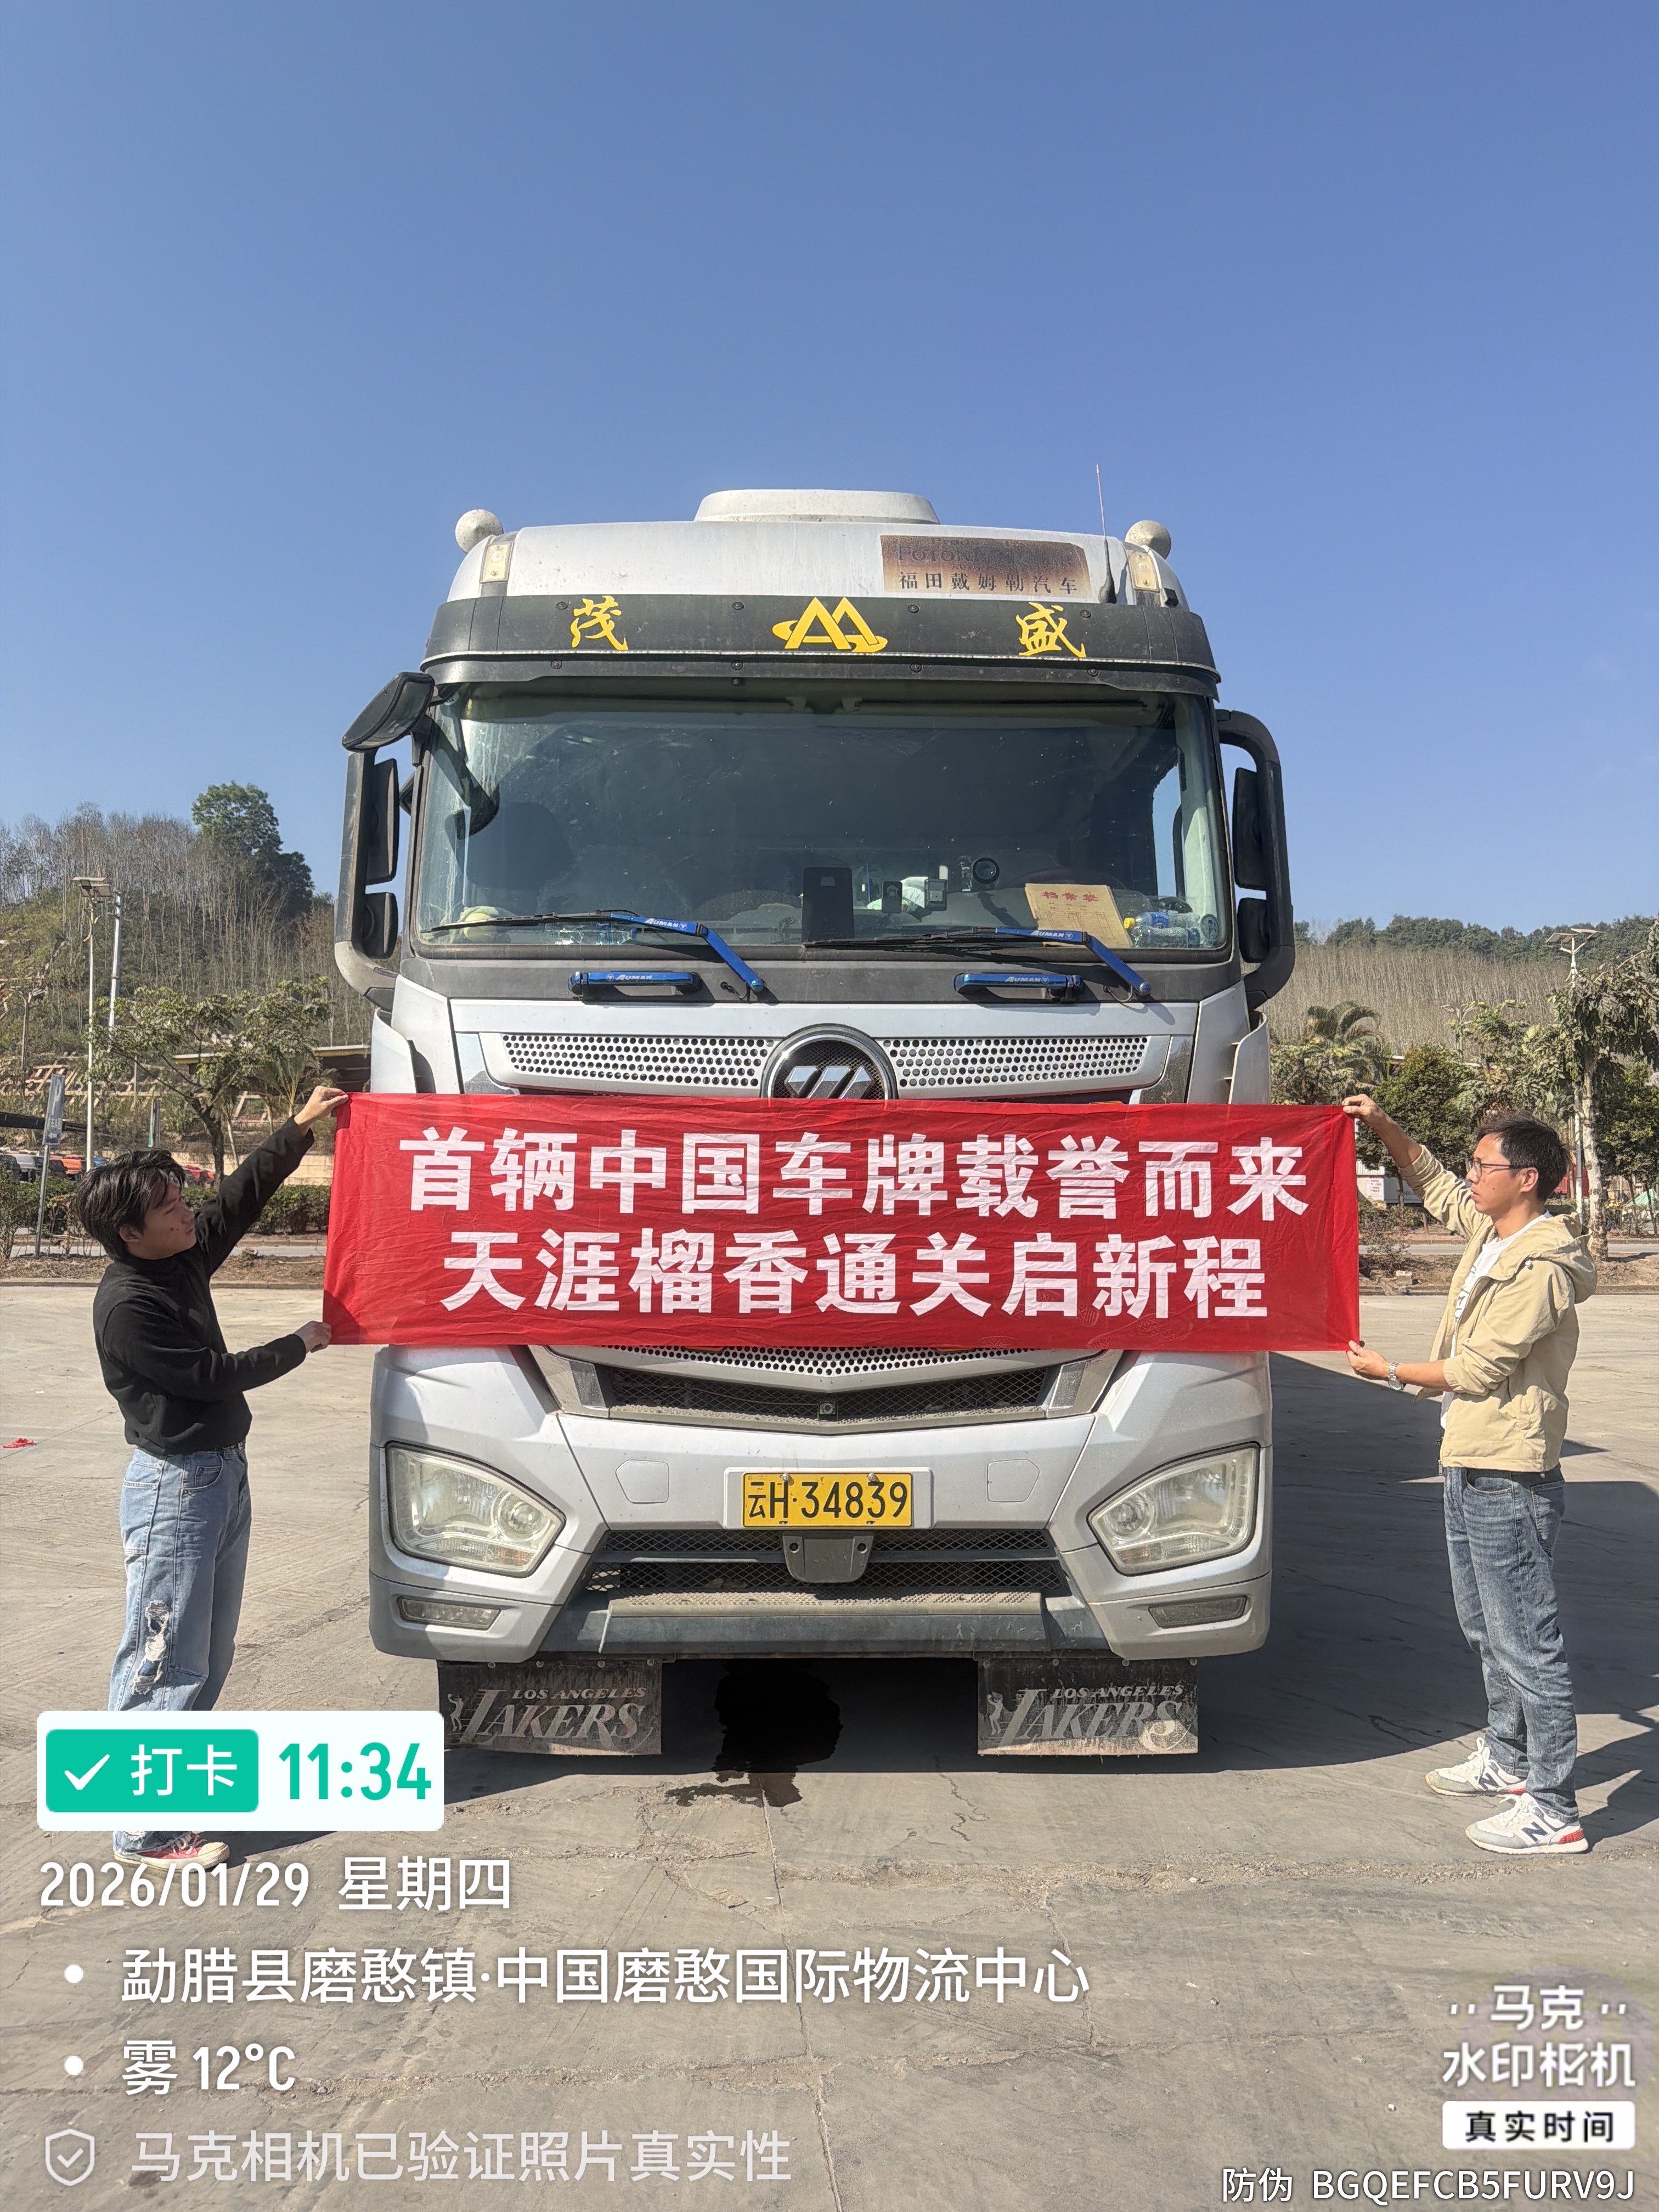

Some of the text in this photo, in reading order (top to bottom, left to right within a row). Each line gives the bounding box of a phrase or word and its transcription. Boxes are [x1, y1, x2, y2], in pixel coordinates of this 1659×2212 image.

[899, 571, 1077, 595] 福田戴姆勒汽车
[571, 595, 1086, 658] 茂 盛
[1042, 891, 1099, 902] 档案袋
[644, 918, 679, 928] AUMAN
[399, 1126, 1309, 1221] 首辆中国车牌载誉而来
[440, 1227, 1268, 1319] 天涯榴香通关启新程
[511, 1687, 646, 1700] LOS ANGELES
[1052, 1685, 1184, 1699] LOS ANGELES
[459, 1689, 645, 1751] LAKERS
[998, 1689, 1190, 1751] LAKERS
